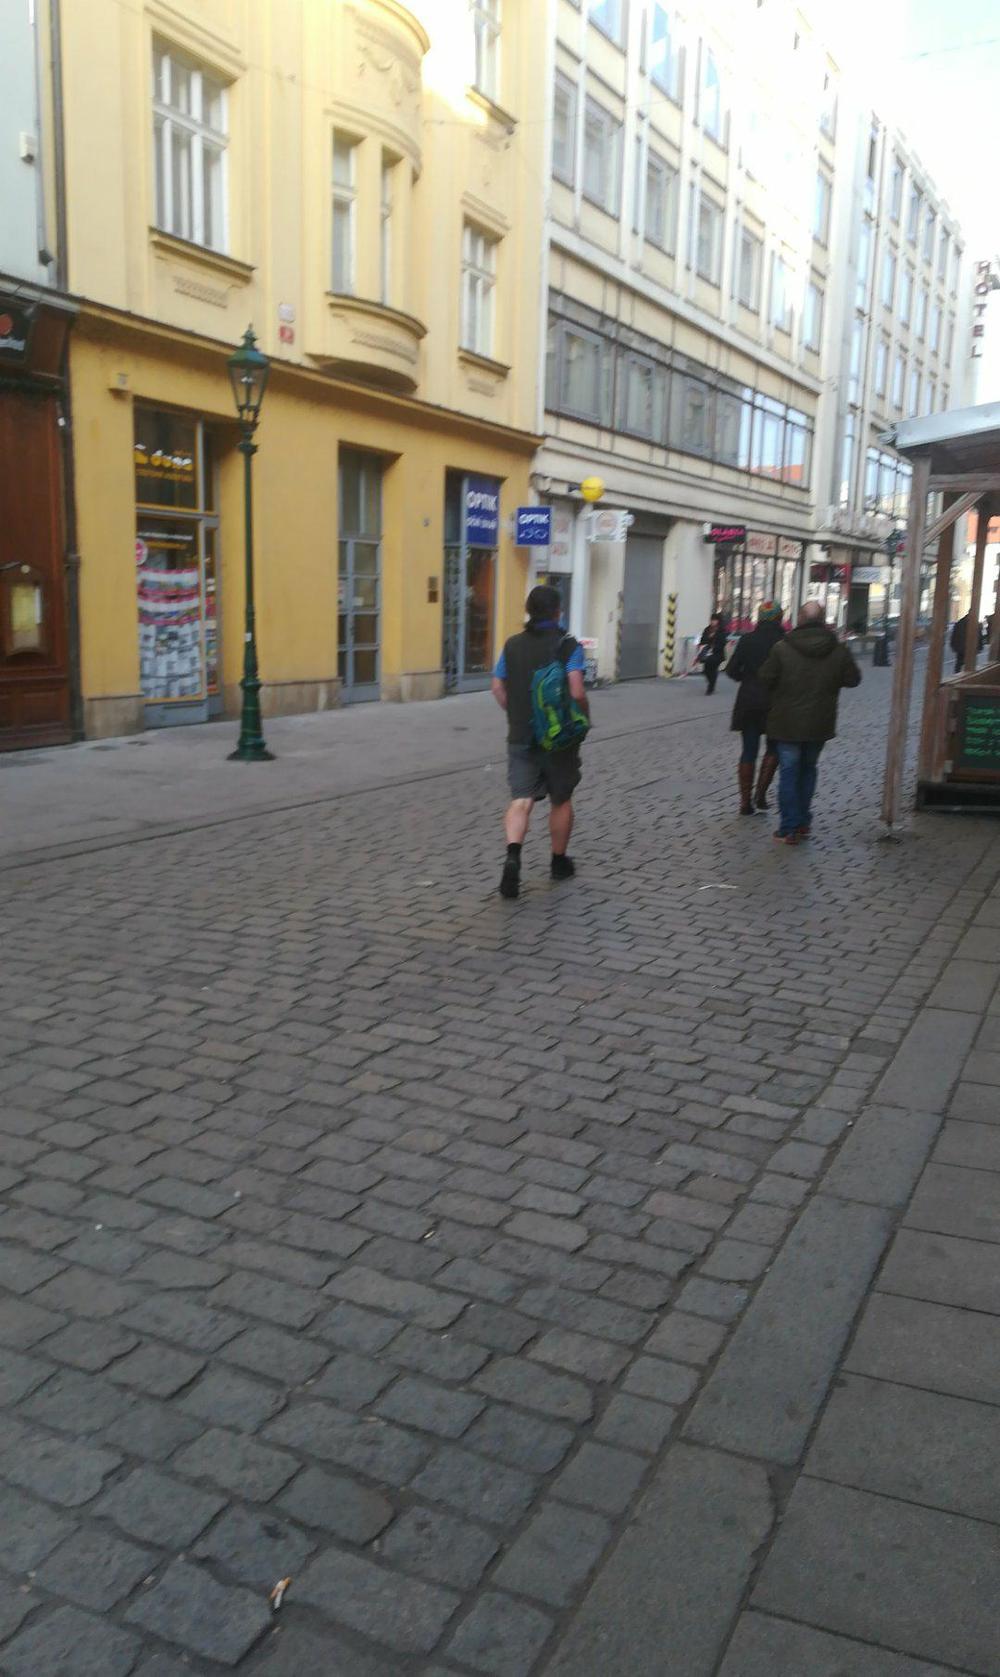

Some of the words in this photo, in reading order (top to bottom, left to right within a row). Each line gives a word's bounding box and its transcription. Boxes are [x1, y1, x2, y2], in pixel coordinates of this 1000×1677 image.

[970, 260, 991, 358] HOTEL
[466, 490, 498, 512] OPTIK
[518, 513, 549, 525] OPTIK
